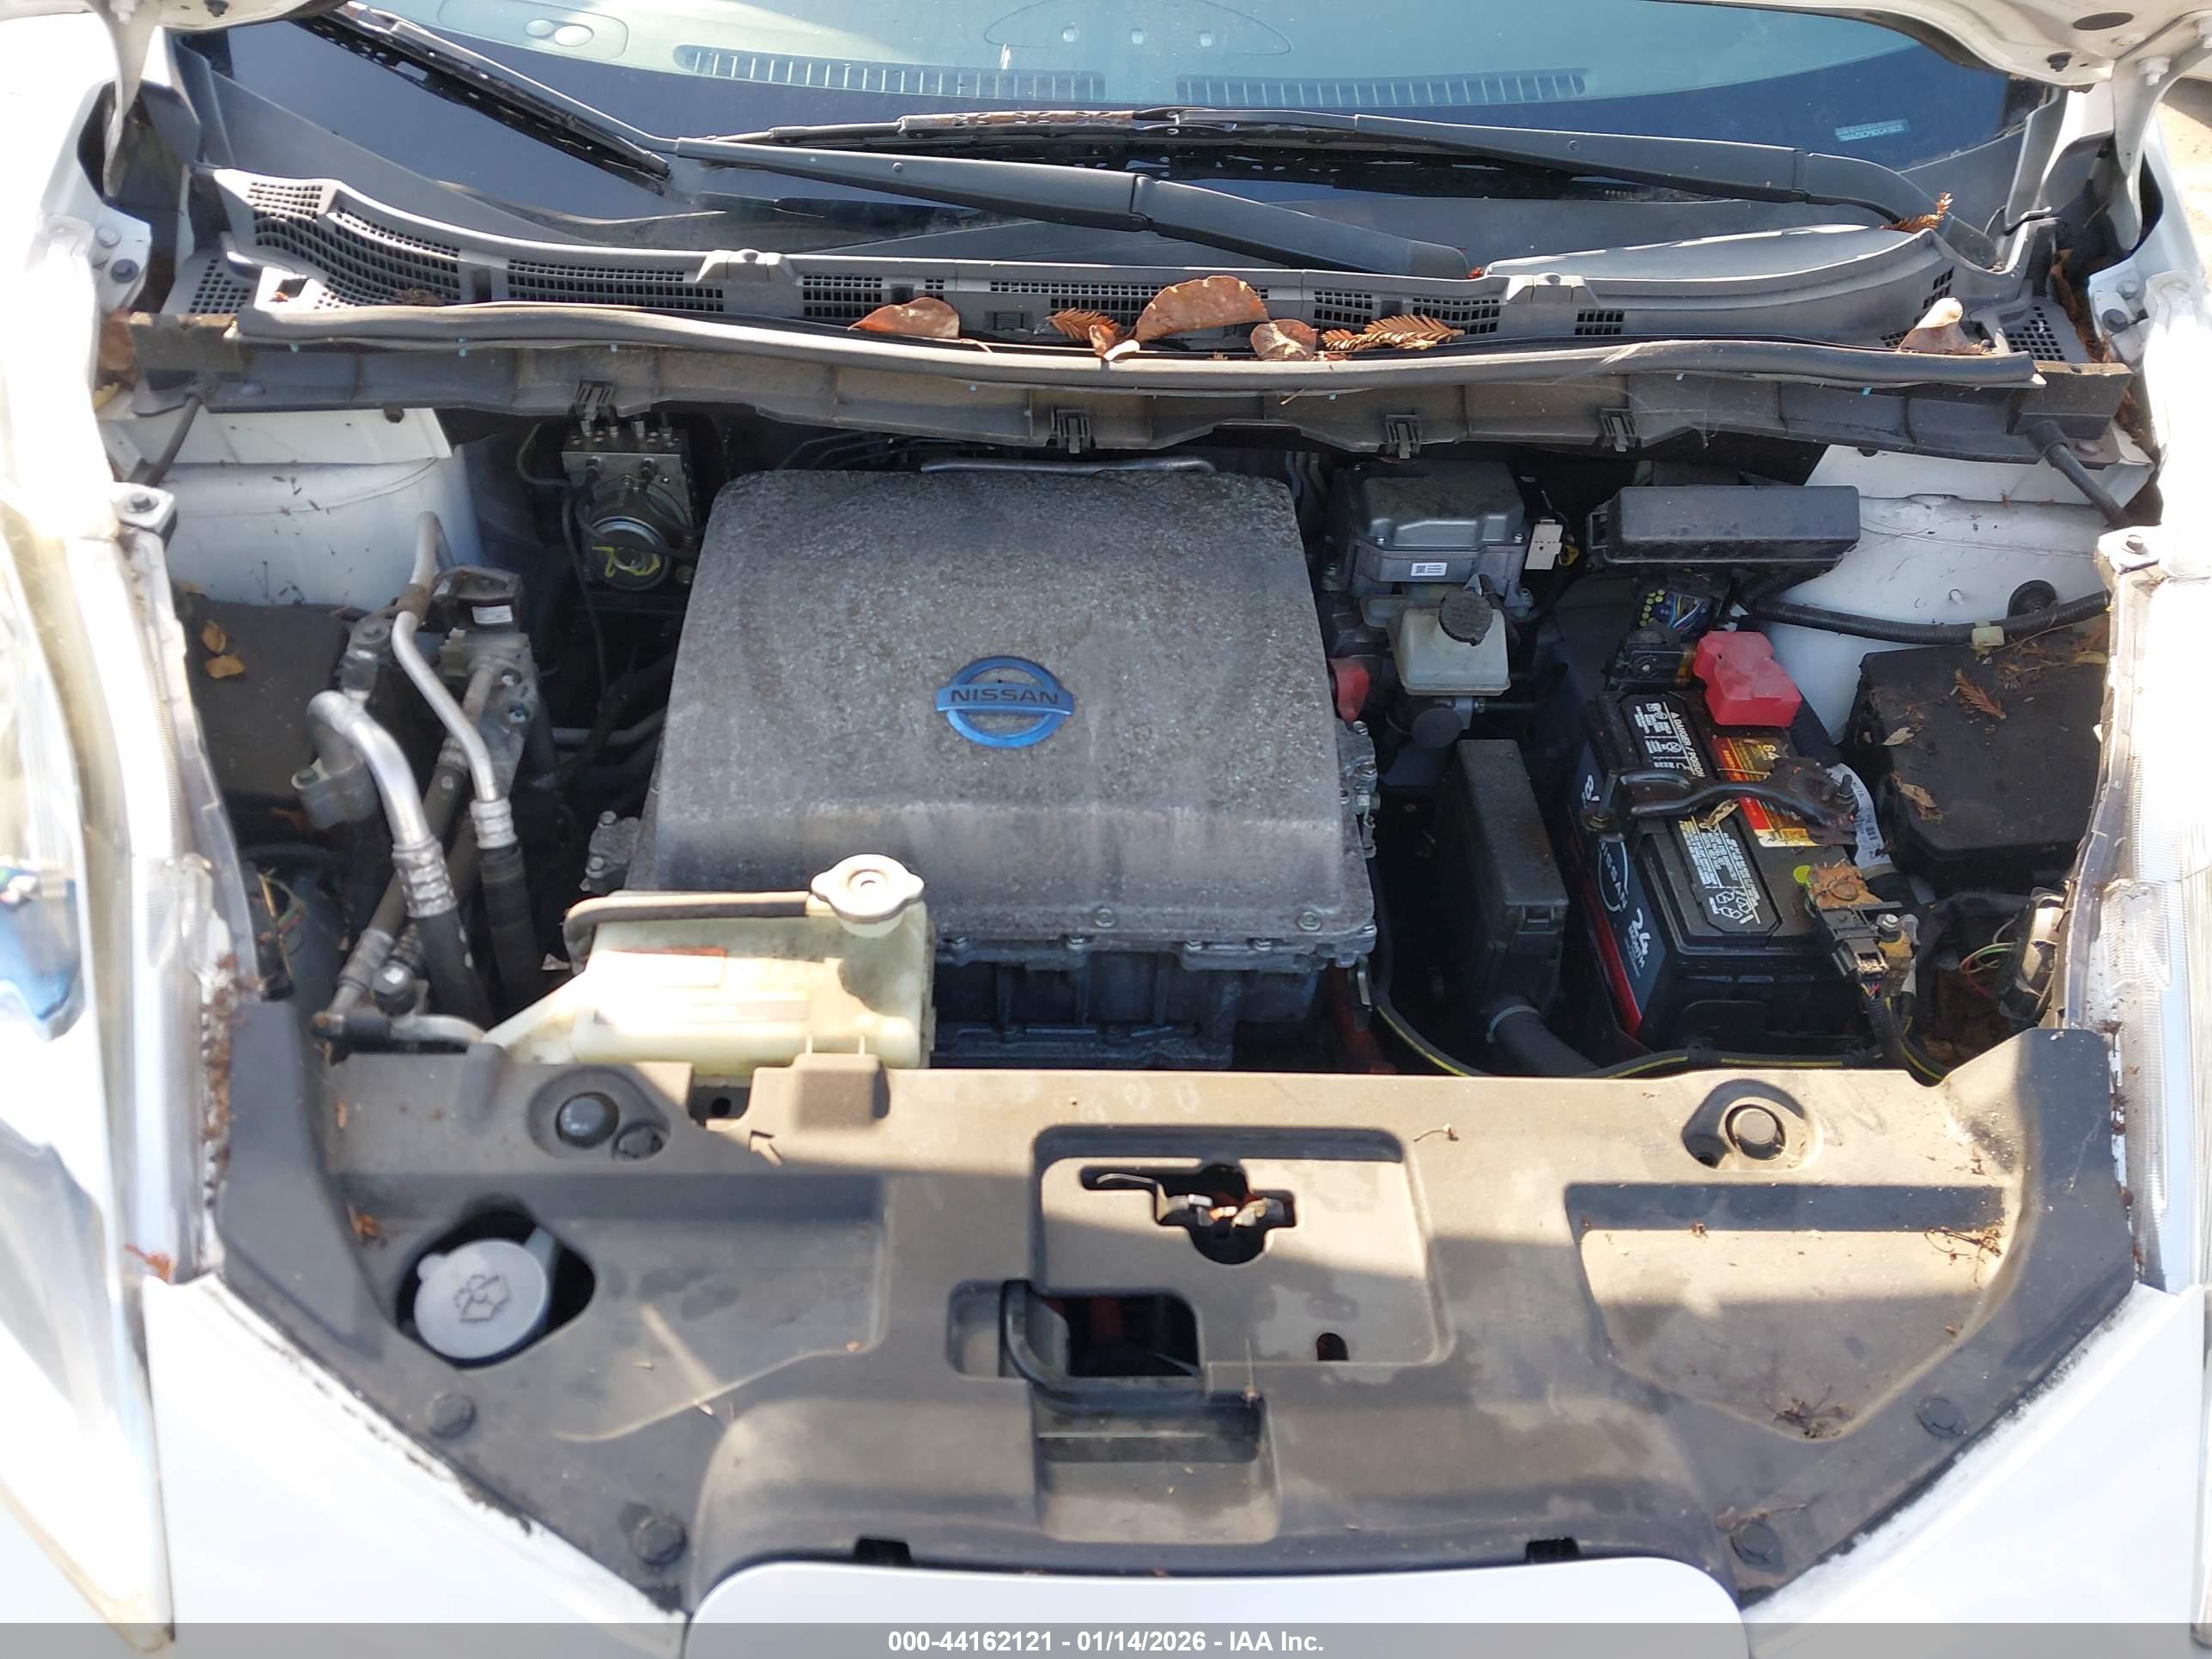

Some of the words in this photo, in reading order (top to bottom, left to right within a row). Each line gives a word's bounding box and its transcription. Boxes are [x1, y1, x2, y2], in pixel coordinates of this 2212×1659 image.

[951, 688, 1059, 706] NISSAN
[1673, 719, 1692, 745] DANGER
[1688, 751, 1706, 777] POISON
[1631, 907, 1652, 956] 24
